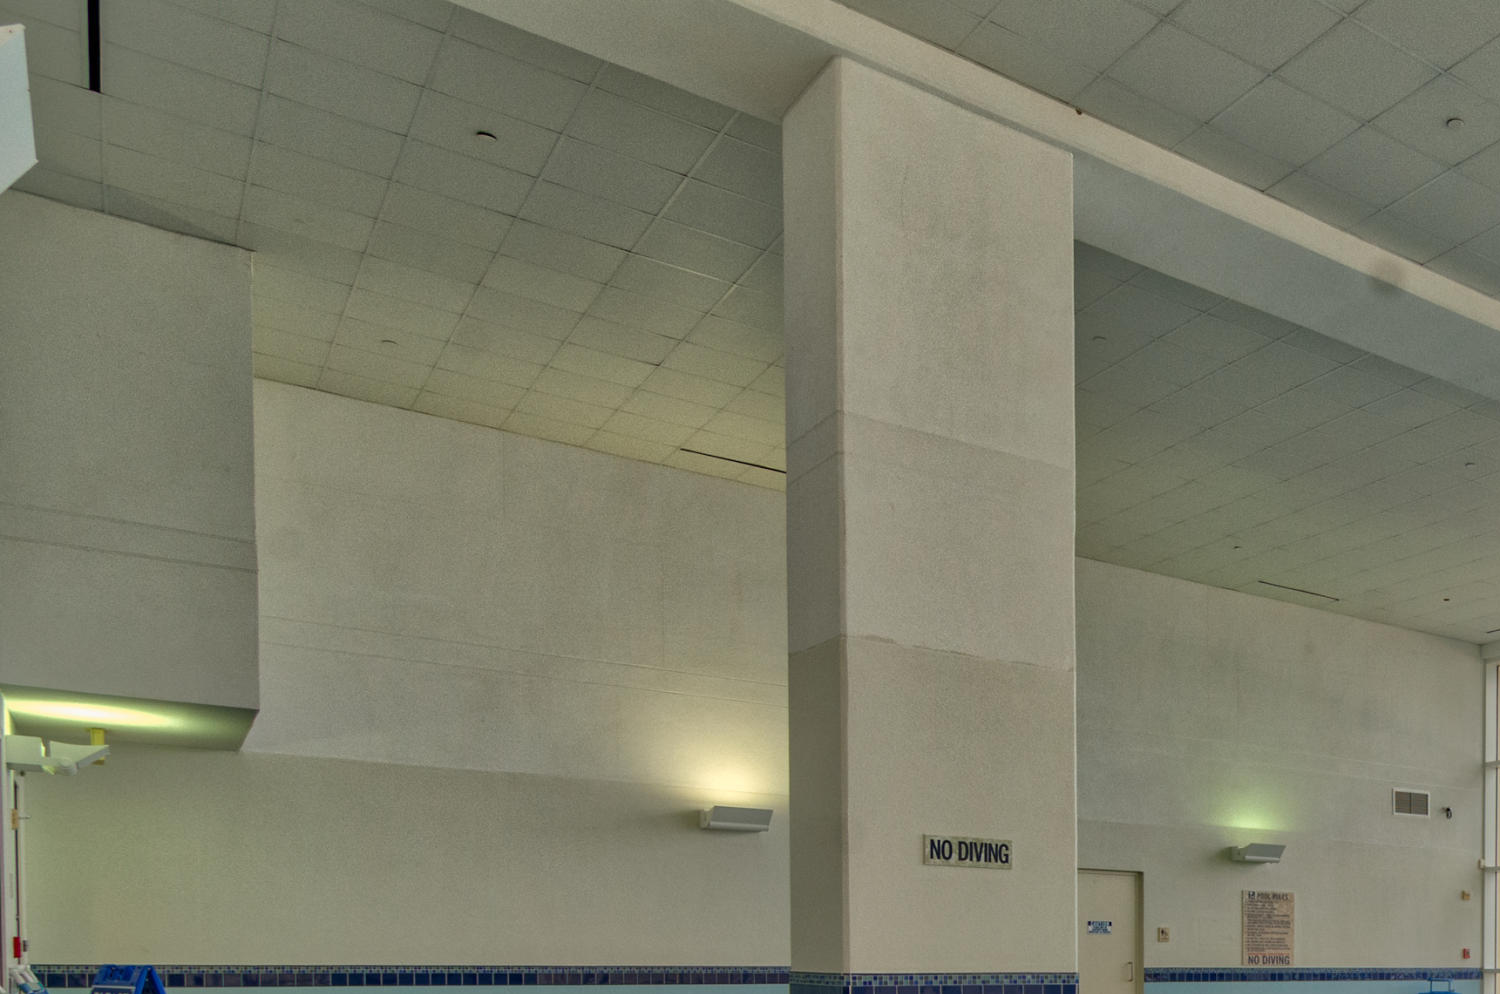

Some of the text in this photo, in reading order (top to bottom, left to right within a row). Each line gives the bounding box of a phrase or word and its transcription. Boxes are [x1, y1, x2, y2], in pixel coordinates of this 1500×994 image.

[930, 839, 1009, 864] NO DIVING
[1248, 955, 1290, 965] NO DIVING
